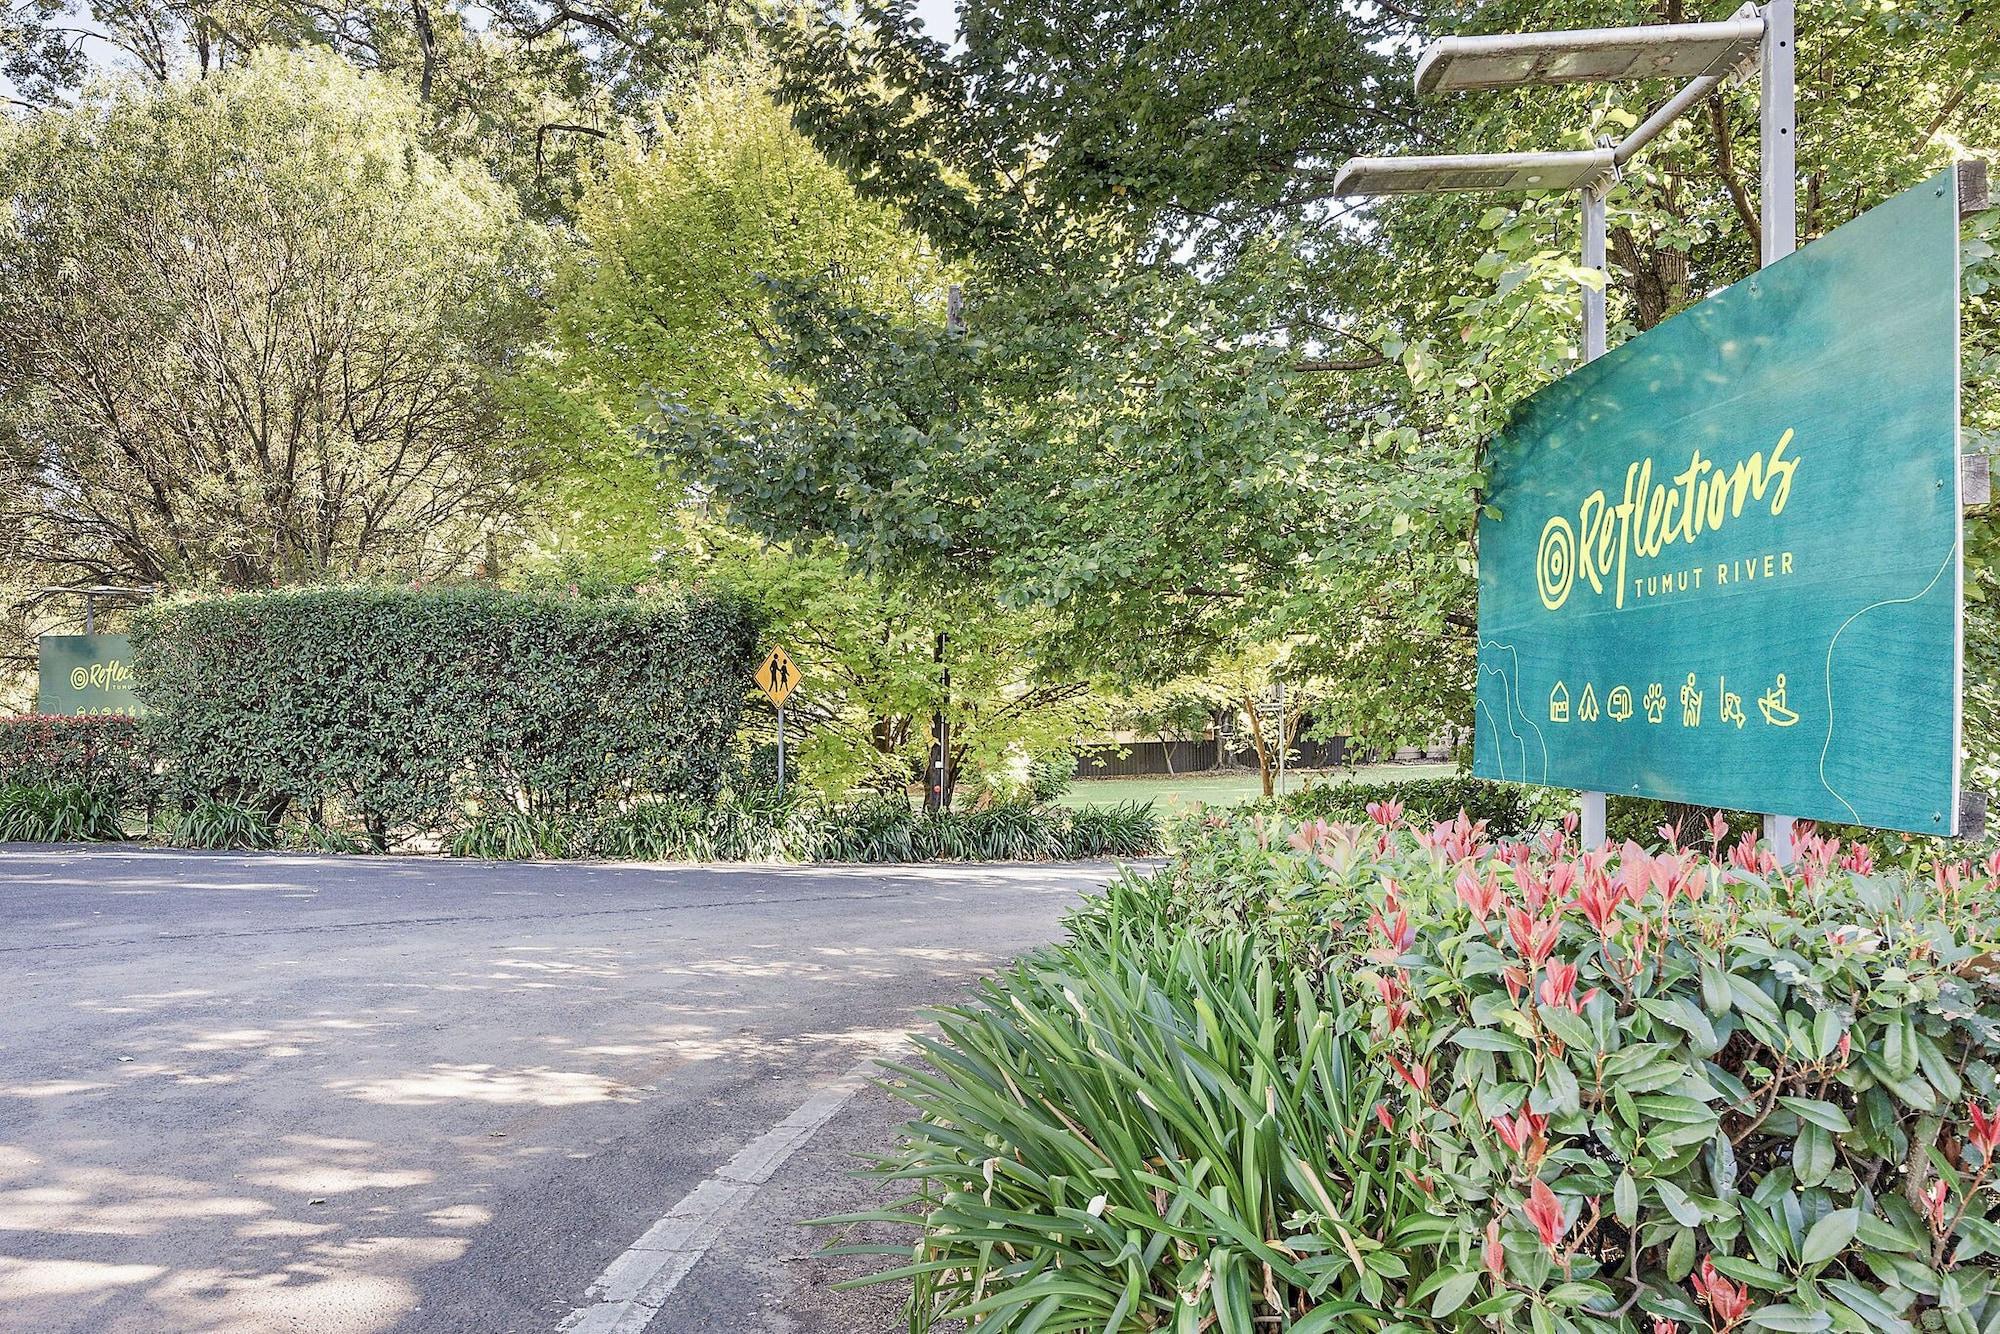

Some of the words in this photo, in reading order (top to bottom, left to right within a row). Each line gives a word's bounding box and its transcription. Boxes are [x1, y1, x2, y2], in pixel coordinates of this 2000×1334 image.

[1579, 427, 1801, 609] Reflections
[1635, 568, 1703, 598] TUMUT
[1718, 552, 1794, 585] RIVER
